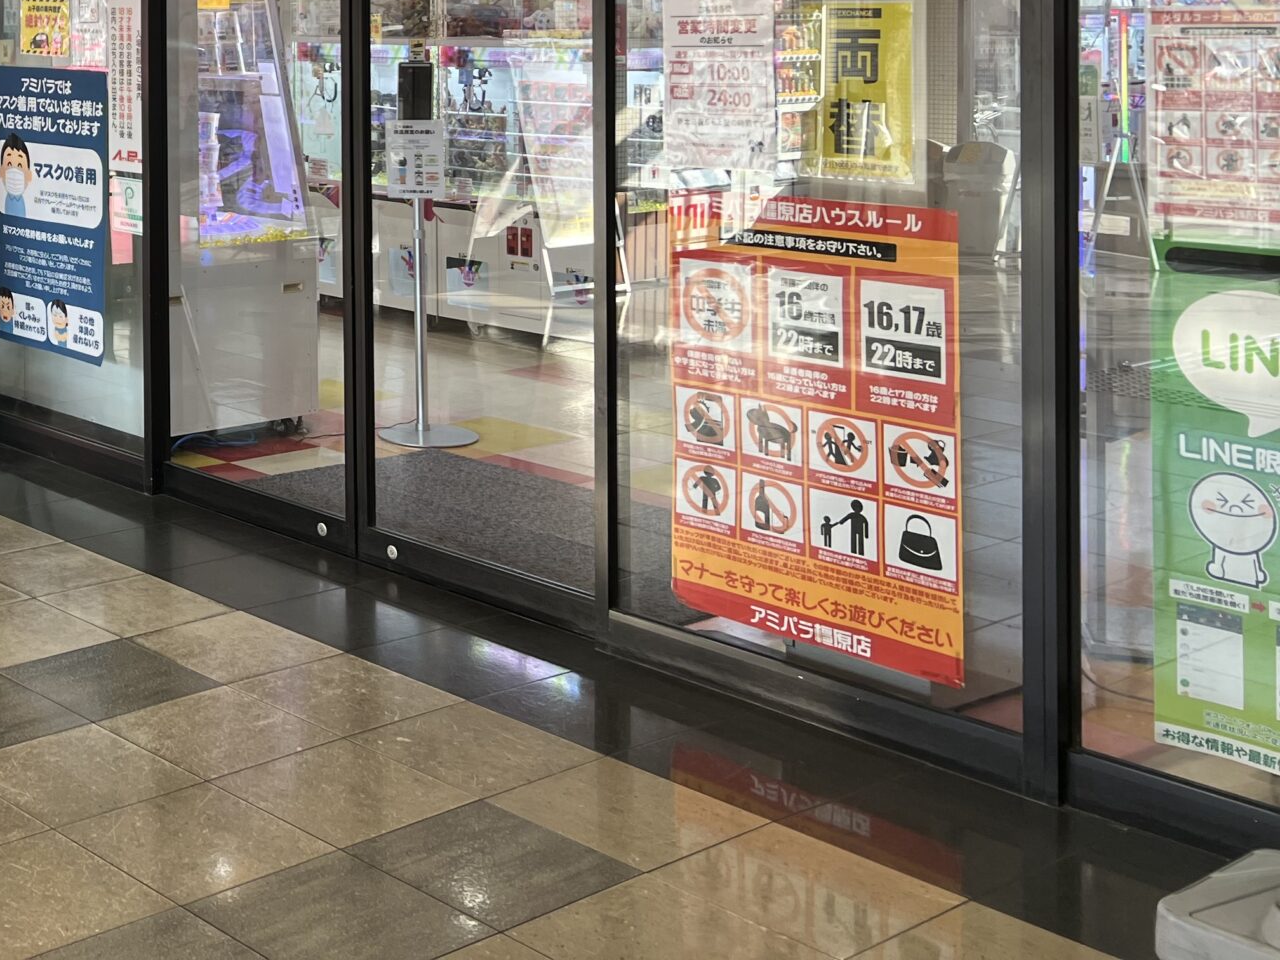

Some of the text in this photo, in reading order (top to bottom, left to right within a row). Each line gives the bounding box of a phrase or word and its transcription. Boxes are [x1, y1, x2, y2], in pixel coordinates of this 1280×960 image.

[677, 19, 758, 35] 営業時間変更
[699, 36, 733, 44] のお知らせ
[21, 77, 72, 94] アミパラでは
[33, 162, 97, 185] マスクの着用
[694, 196, 923, 233] ミパラ橿原店ハウスルール
[863, 299, 943, 339] 16,17歳
[871, 341, 936, 372] 22時まで
[679, 559, 954, 649] マナーを守って楽しくお遊びください
[750, 605, 872, 658] アミパラ橿原店
[1162, 728, 1280, 771] お得な情報や最新
